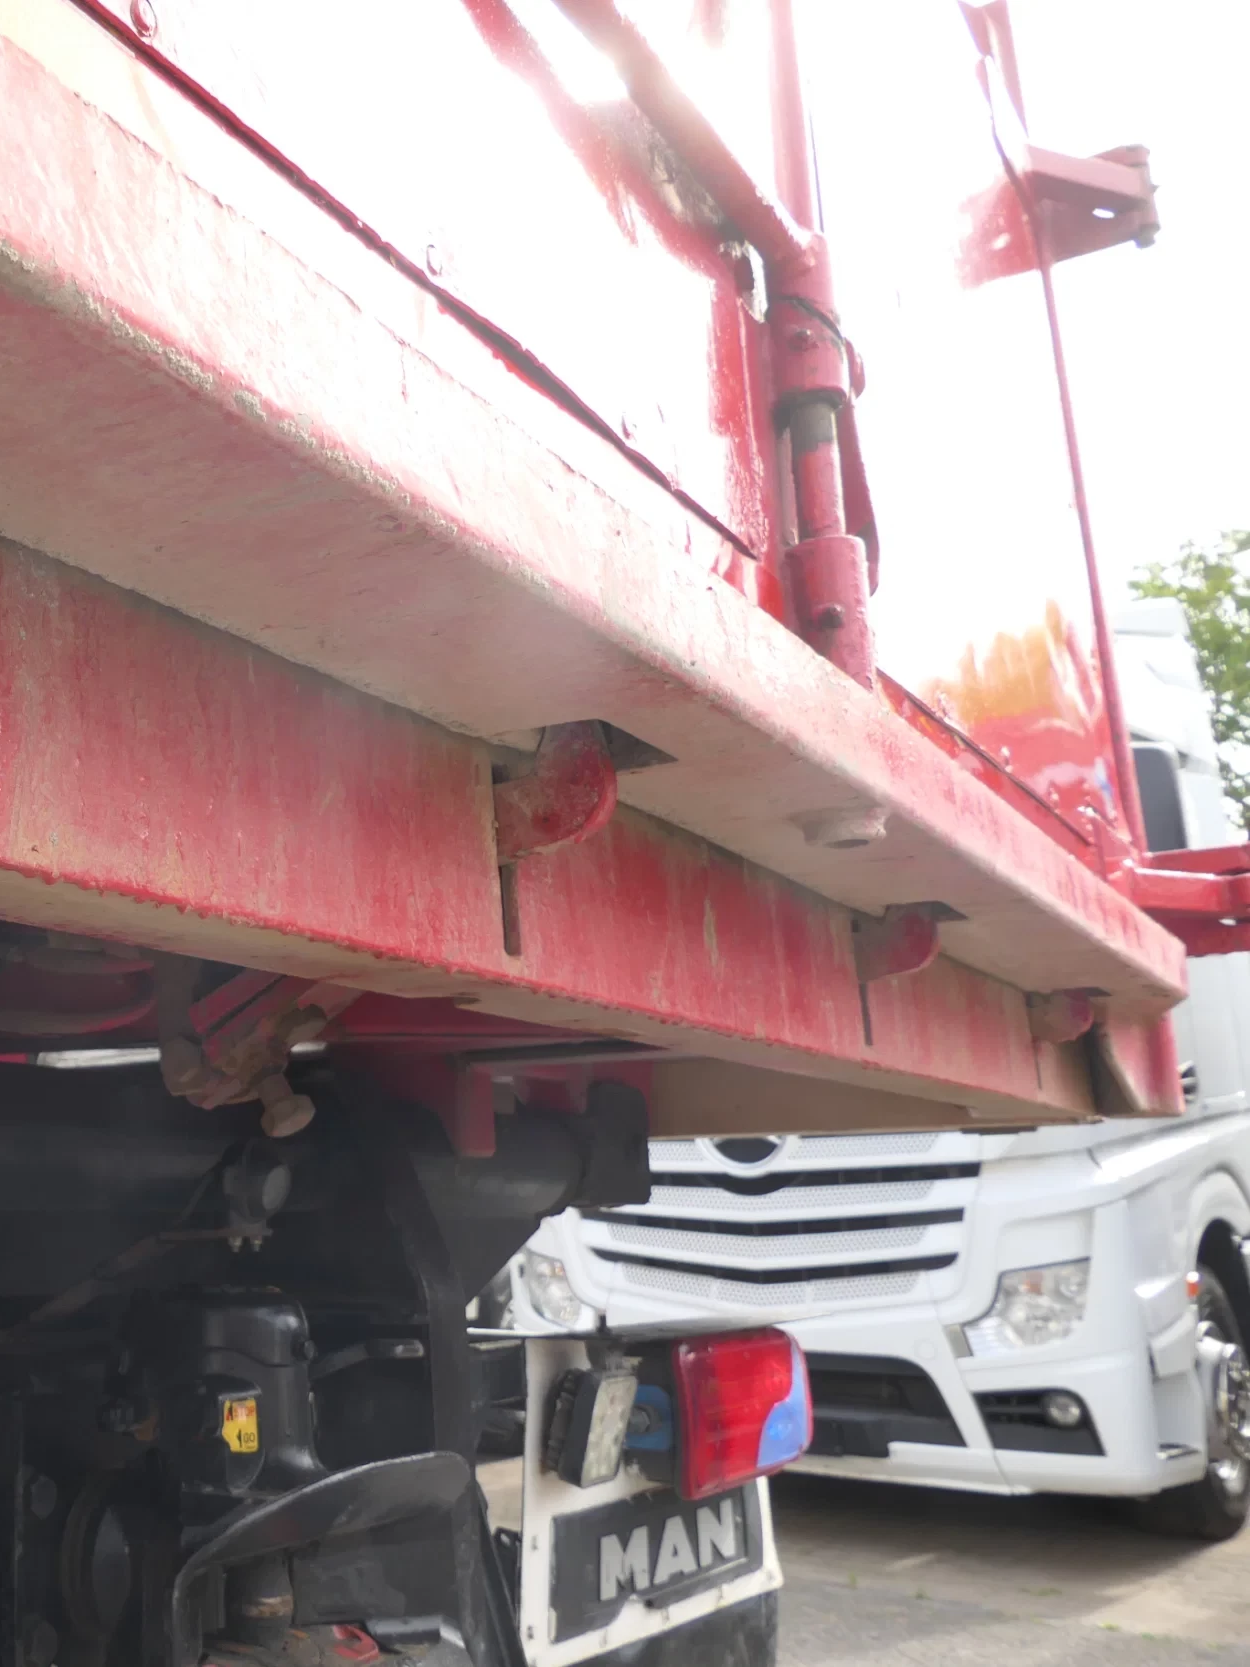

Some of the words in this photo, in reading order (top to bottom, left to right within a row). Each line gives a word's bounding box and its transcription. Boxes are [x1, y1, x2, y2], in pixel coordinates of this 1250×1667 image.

[233, 1405, 255, 1417] STOP
[243, 1432, 256, 1444] GO
[600, 1499, 736, 1601] MAN
